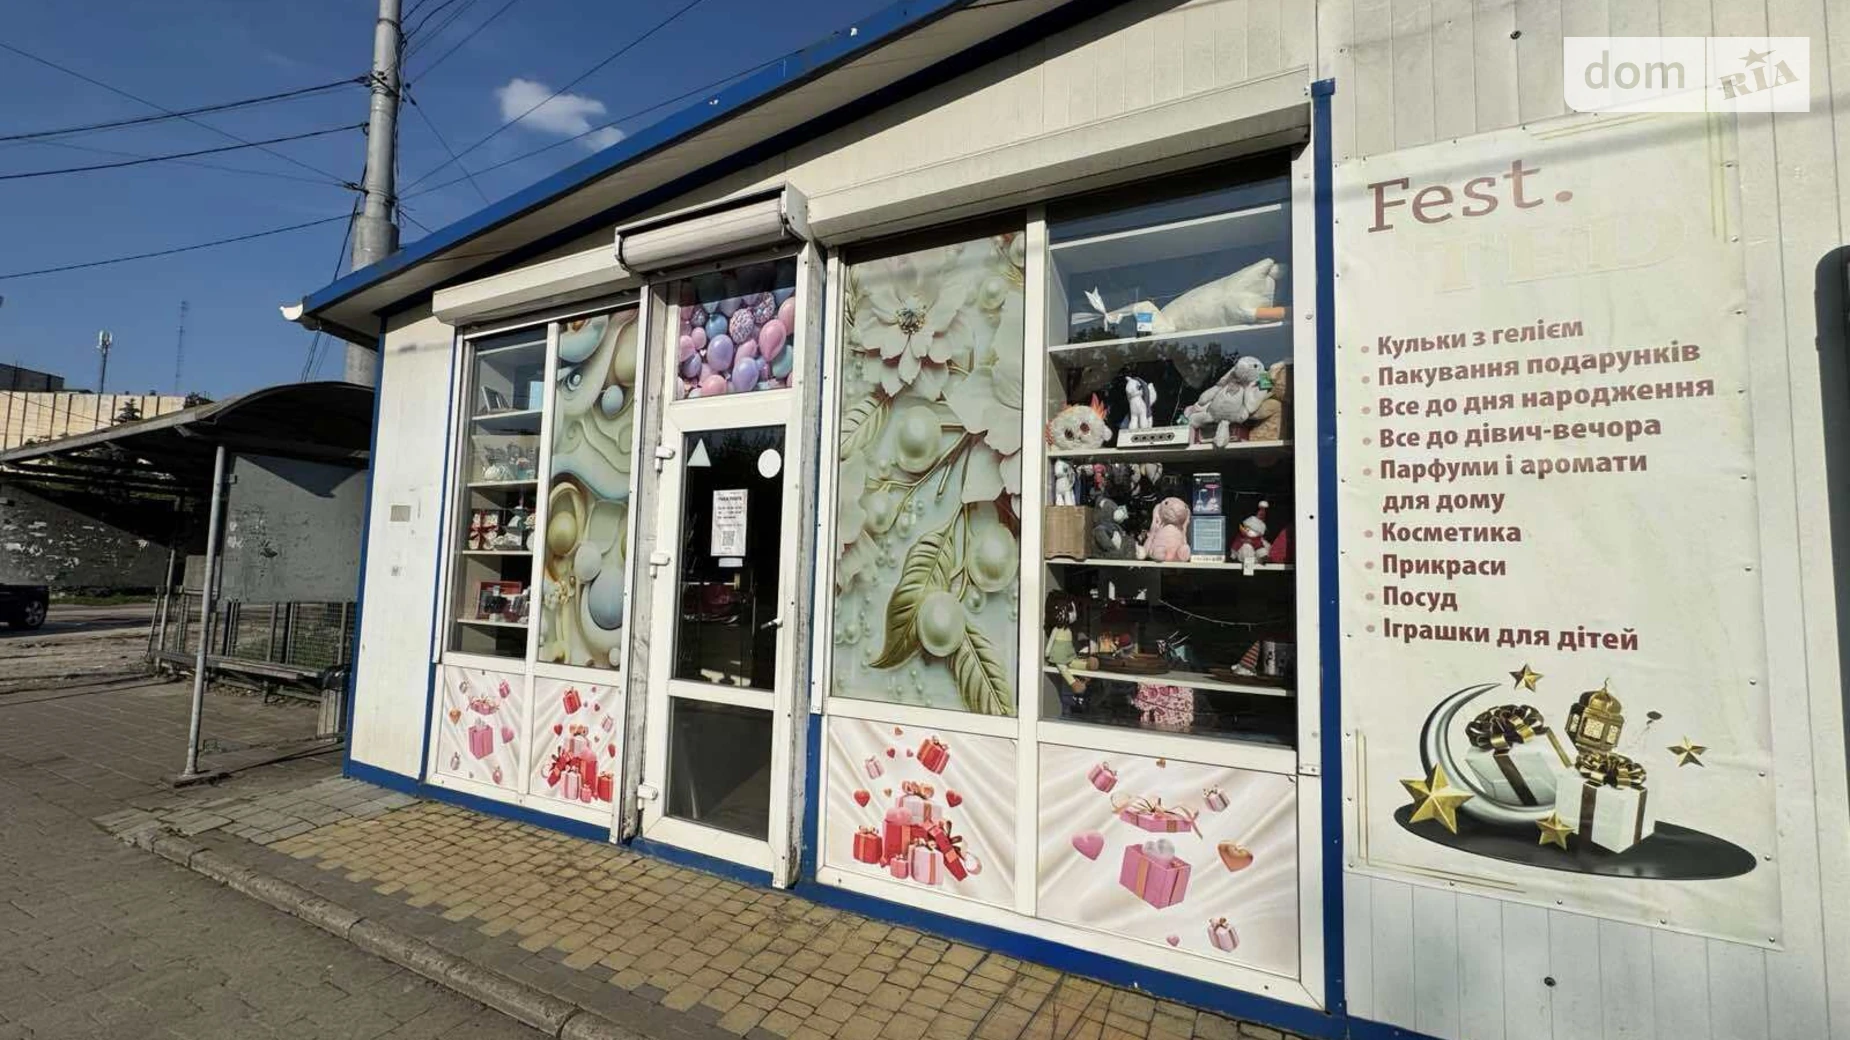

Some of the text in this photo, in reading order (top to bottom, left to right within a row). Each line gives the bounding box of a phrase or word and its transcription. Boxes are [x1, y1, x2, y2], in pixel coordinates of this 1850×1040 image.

[1367, 159, 1573, 233] Fest.
[1378, 319, 1583, 359] Кульки з гелієм
[1378, 340, 1700, 388] Пакування подарунків
[1379, 379, 1714, 418] Все до дня народження
[1380, 418, 1662, 449] Все до дівич-вечора
[1380, 454, 1647, 483] Парфуми і аромати
[1383, 493, 1505, 513] для дому
[1381, 523, 1522, 542] Косметика
[1382, 554, 1506, 580] Прикраси
[1383, 586, 1458, 612] Посуд
[1384, 618, 1639, 651] Іграшки для дітей
